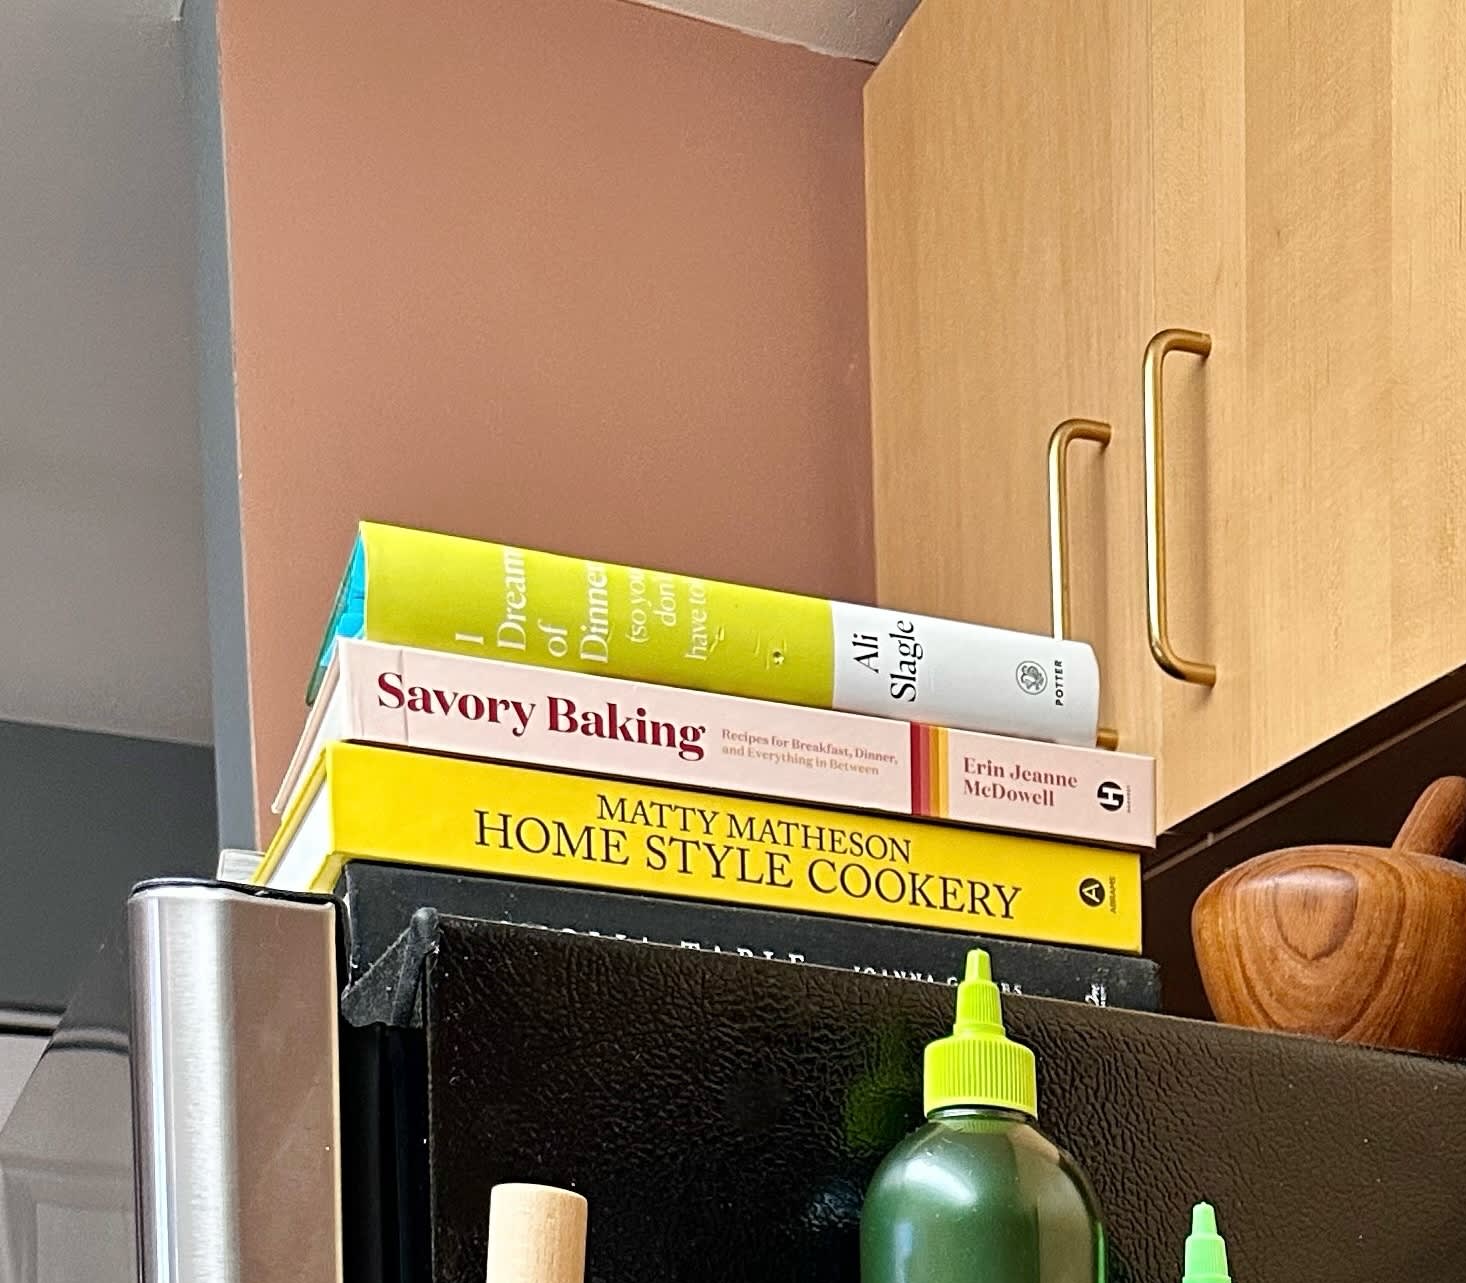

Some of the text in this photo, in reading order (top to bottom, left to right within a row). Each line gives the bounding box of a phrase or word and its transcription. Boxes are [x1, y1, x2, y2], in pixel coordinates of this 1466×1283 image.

[496, 545, 527, 651] Dream
[454, 631, 485, 645] I
[537, 618, 569, 658] of
[684, 608, 708, 661] have
[851, 632, 880, 674] Ali
[888, 619, 924, 703] Slagle
[1054, 659, 1065, 707] POTTER
[376, 671, 706, 762] Savory Baking
[721, 728, 899, 766] Recipes for Breakfast, Dinner,
[721, 743, 880, 776] and Everything in Between
[963, 756, 1079, 789] Erin Jeanne
[963, 778, 1056, 808] McDowell
[596, 793, 912, 864] MATTY MATHESON
[473, 809, 1023, 921] HOME STYLE COOKERY
